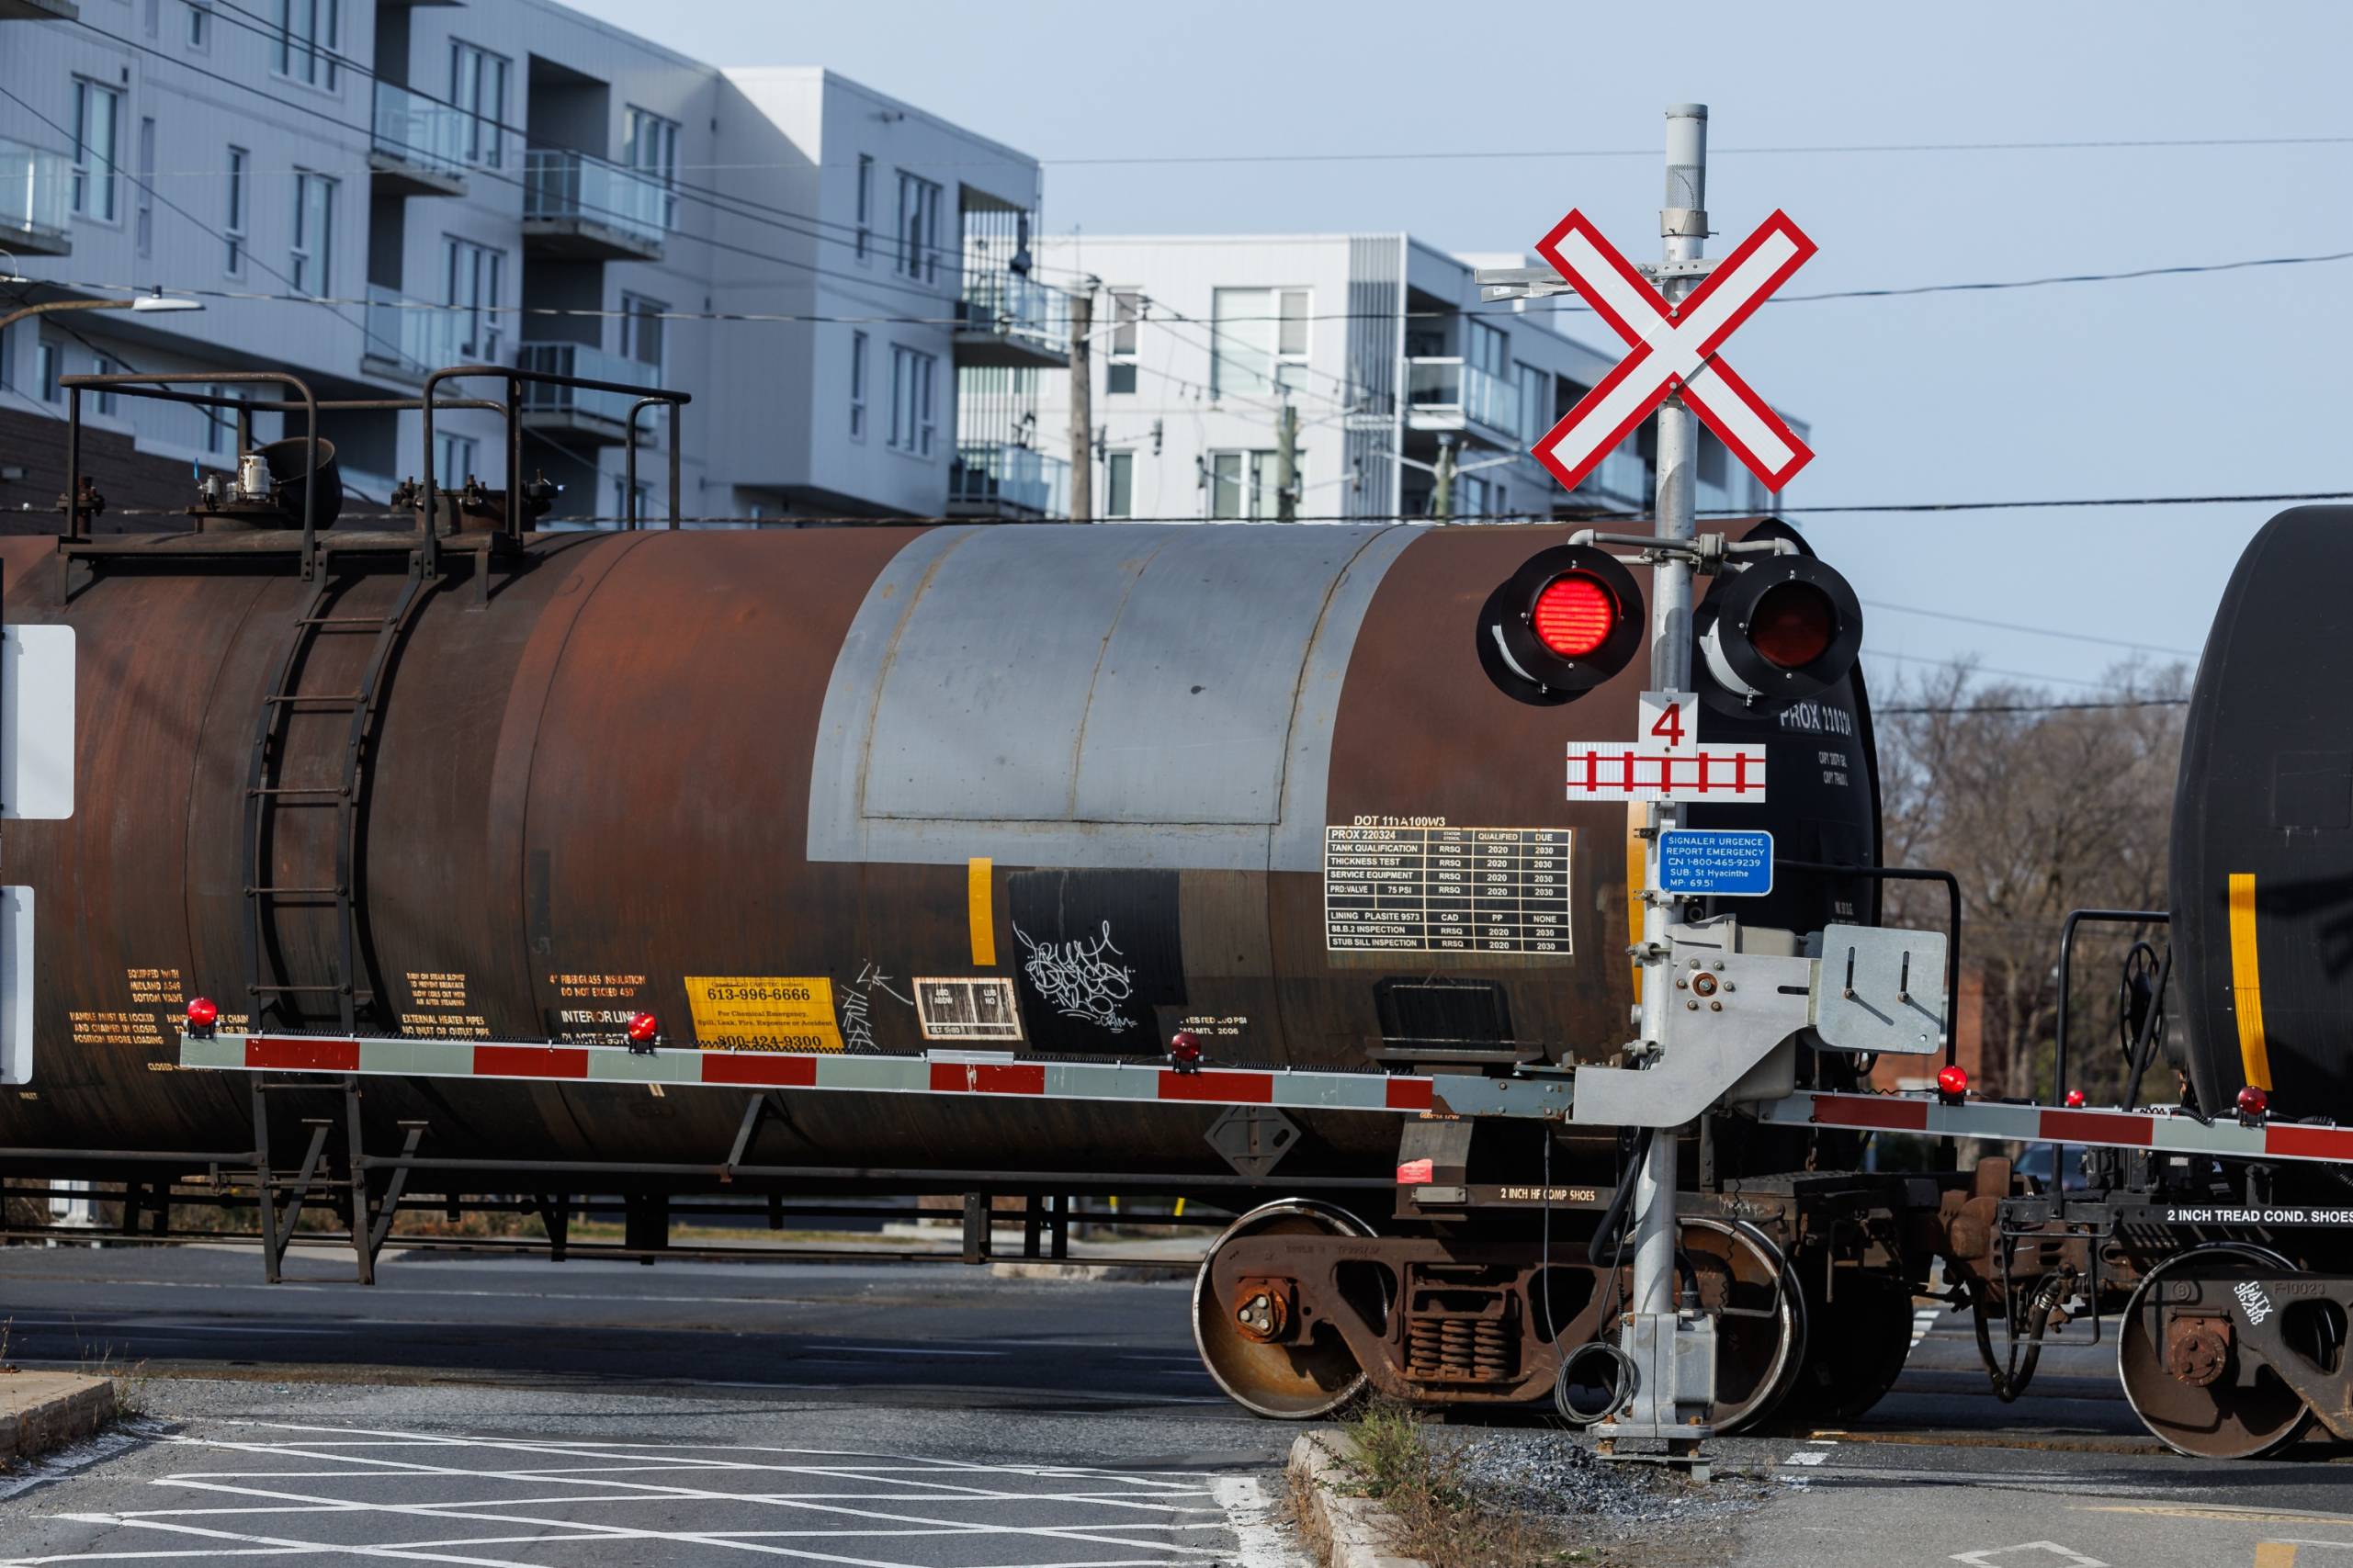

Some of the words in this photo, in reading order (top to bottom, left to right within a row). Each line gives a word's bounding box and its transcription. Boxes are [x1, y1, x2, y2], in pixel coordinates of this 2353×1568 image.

[1780, 703, 1820, 729] PROX
[1652, 704, 1685, 746] 4
[1354, 816, 1378, 826] DOT
[1383, 817, 1445, 827] 111A100W3
[1708, 870, 1748, 878] Hyacinthe
[128, 969, 158, 978] EQUIPPED
[561, 975, 601, 985] FIBERGLASS
[130, 982, 161, 990] MIDLAND
[561, 988, 571, 997] DO
[575, 988, 589, 997] NOT
[593, 988, 617, 997] EXCEED
[708, 988, 809, 1000] 613-996-6666
[132, 994, 161, 1002] BOTTOM
[164, 994, 183, 1002] VALVE
[70, 1012, 96, 1021] HANDLE
[99, 1013, 117, 1021] MUST
[130, 1014, 154, 1022] LOCKED
[402, 1015, 436, 1023] EXTERNAL
[439, 1015, 464, 1024] HEATER
[466, 1017, 484, 1025] PIPES
[75, 1024, 88, 1032] AND
[92, 1024, 119, 1032] CHAINED
[134, 1025, 157, 1033] CLOSED
[417, 1027, 434, 1035] INLET
[449, 1027, 472, 1036] OUTLET
[74, 1035, 104, 1043] POSITION
[107, 1035, 131, 1043] BEFORE
[133, 1036, 164, 1044] LOADING
[718, 1035, 821, 1047] 800-424-9300
[1501, 1188, 1507, 1199] 2
[1510, 1189, 1528, 1198] INCH
[1531, 1189, 1541, 1199] HF
[1570, 1190, 1595, 1201] SHOES
[2167, 1211, 2175, 1221] 2
[2179, 1211, 2211, 1221] INCH
[2215, 1211, 2259, 1222] TREAD
[2264, 1211, 2307, 1222] COND.
